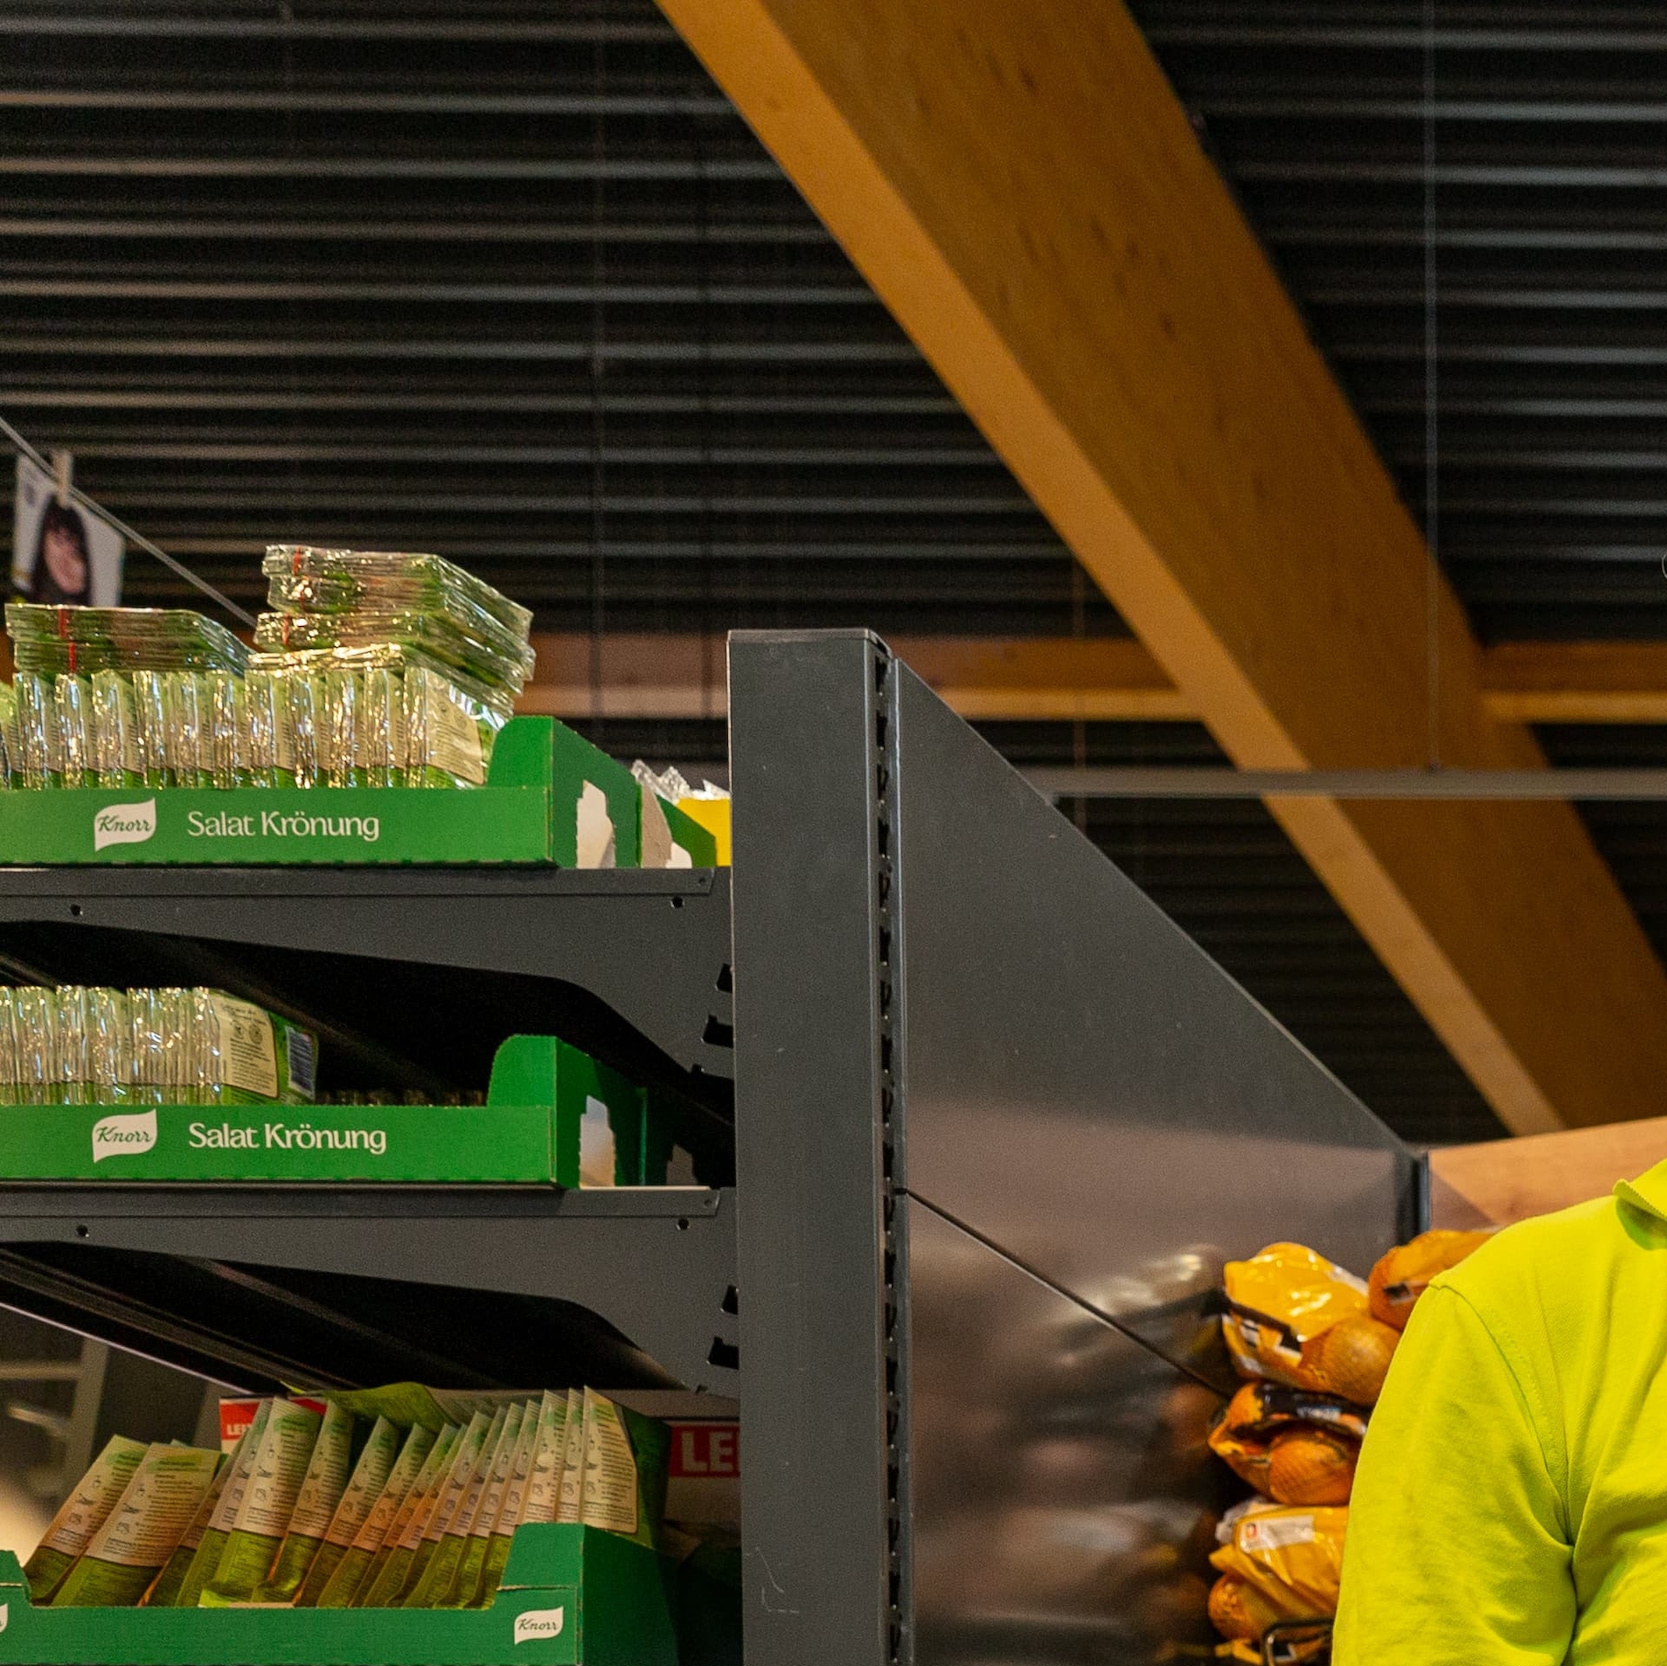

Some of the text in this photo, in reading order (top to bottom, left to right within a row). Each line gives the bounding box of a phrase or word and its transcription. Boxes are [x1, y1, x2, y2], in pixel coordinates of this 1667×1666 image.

[98, 815, 153, 832] Knorr
[187, 810, 380, 841] Salat Krönung
[96, 1126, 153, 1143] Knorr
[189, 1122, 386, 1154] Salat Krönung
[681, 1431, 737, 1461] LE
[518, 1615, 560, 1632] Knorr
